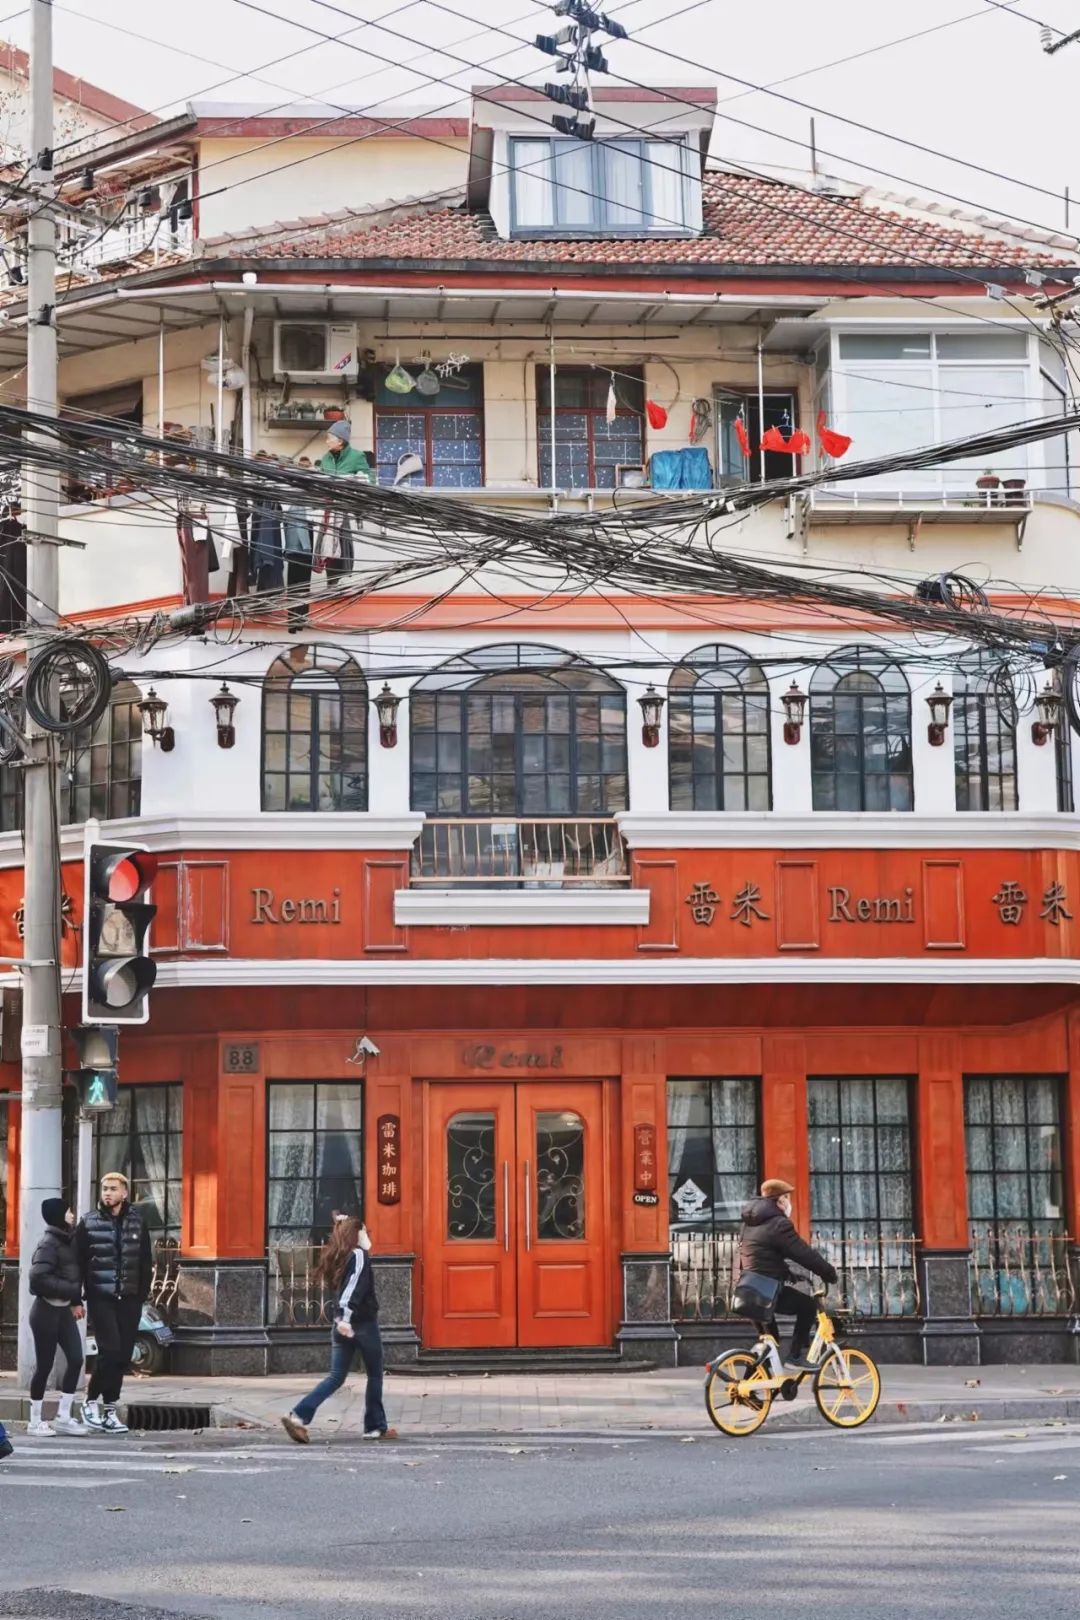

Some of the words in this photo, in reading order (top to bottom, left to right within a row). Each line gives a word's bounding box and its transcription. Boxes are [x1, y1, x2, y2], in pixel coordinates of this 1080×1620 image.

[251, 887, 341, 924] Remi
[684, 880, 770, 926] 雷米
[827, 887, 915, 922] Remi
[992, 880, 1073, 926] 雷米
[229, 1050, 253, 1066] 88
[381, 1122, 397, 1197] 雷米珈琲
[634, 1194, 657, 1204] OPEN
